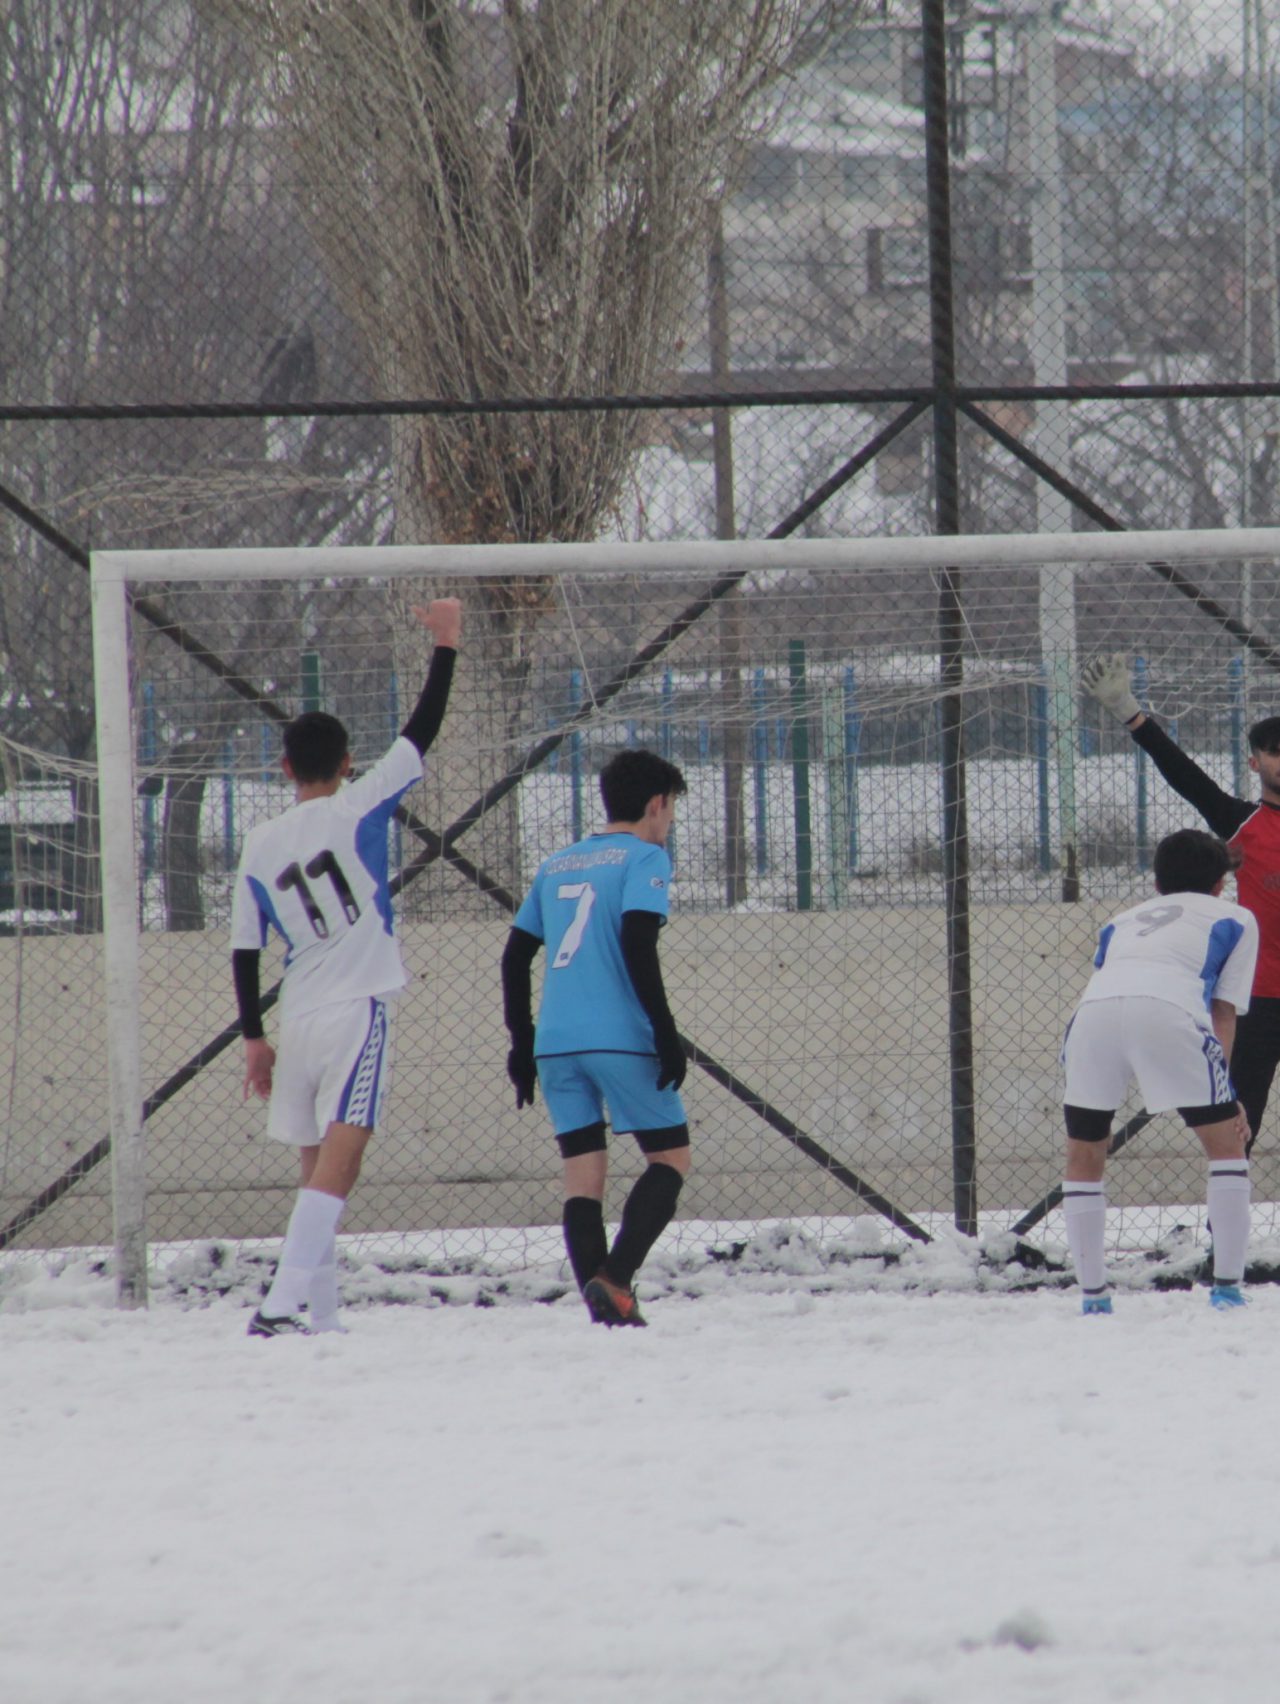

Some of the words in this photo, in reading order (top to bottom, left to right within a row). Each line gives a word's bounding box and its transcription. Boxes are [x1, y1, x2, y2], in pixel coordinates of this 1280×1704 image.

[276, 849, 361, 939] 11
[553, 881, 596, 969] 7
[1135, 904, 1184, 937] 9
